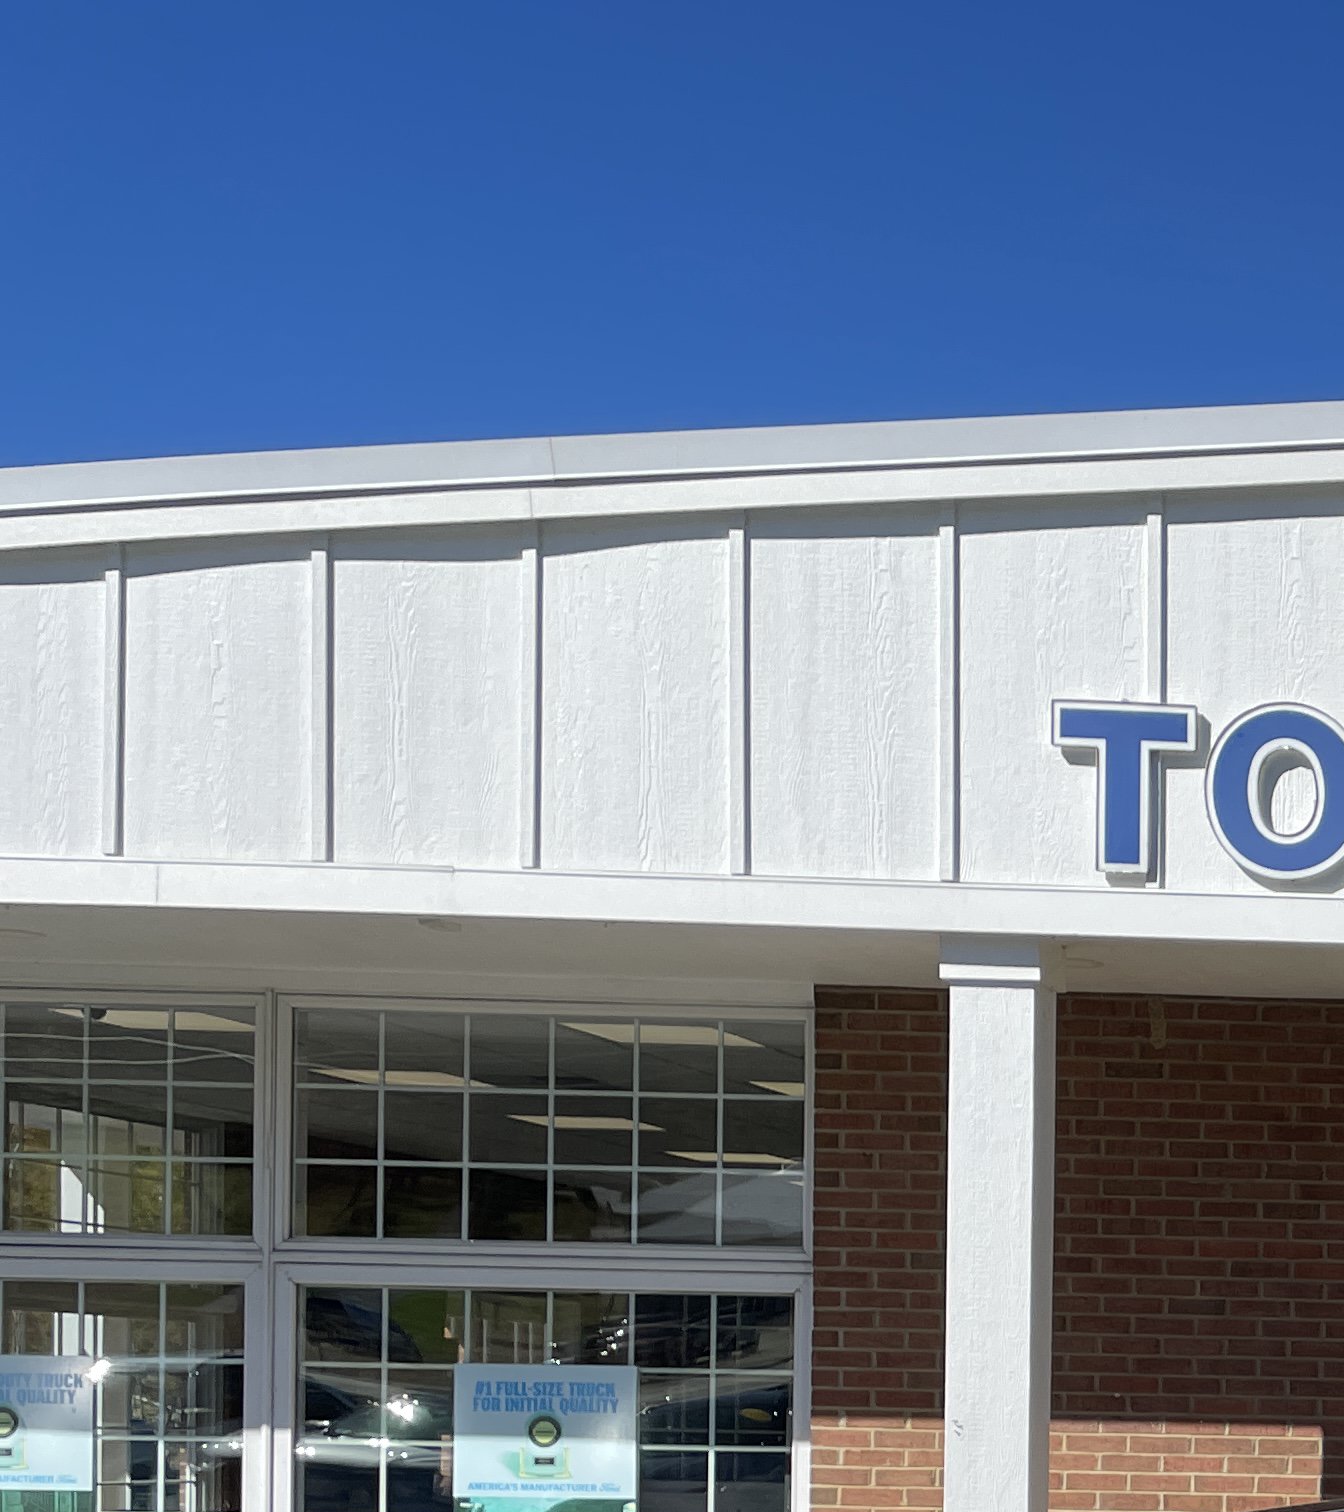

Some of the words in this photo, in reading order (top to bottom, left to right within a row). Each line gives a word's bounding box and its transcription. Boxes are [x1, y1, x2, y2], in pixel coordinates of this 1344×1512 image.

[38, 1373, 83, 1388] TRUCK
[17, 1389, 76, 1406] QUALITY
[496, 1381, 563, 1397] FULL-SIZE
[568, 1382, 616, 1398] TRUCK
[473, 1397, 502, 1412] FOR
[505, 1397, 555, 1413] INITIAL
[559, 1398, 619, 1415] QUALITY
[520, 1482, 597, 1492] MANUFACTURER
